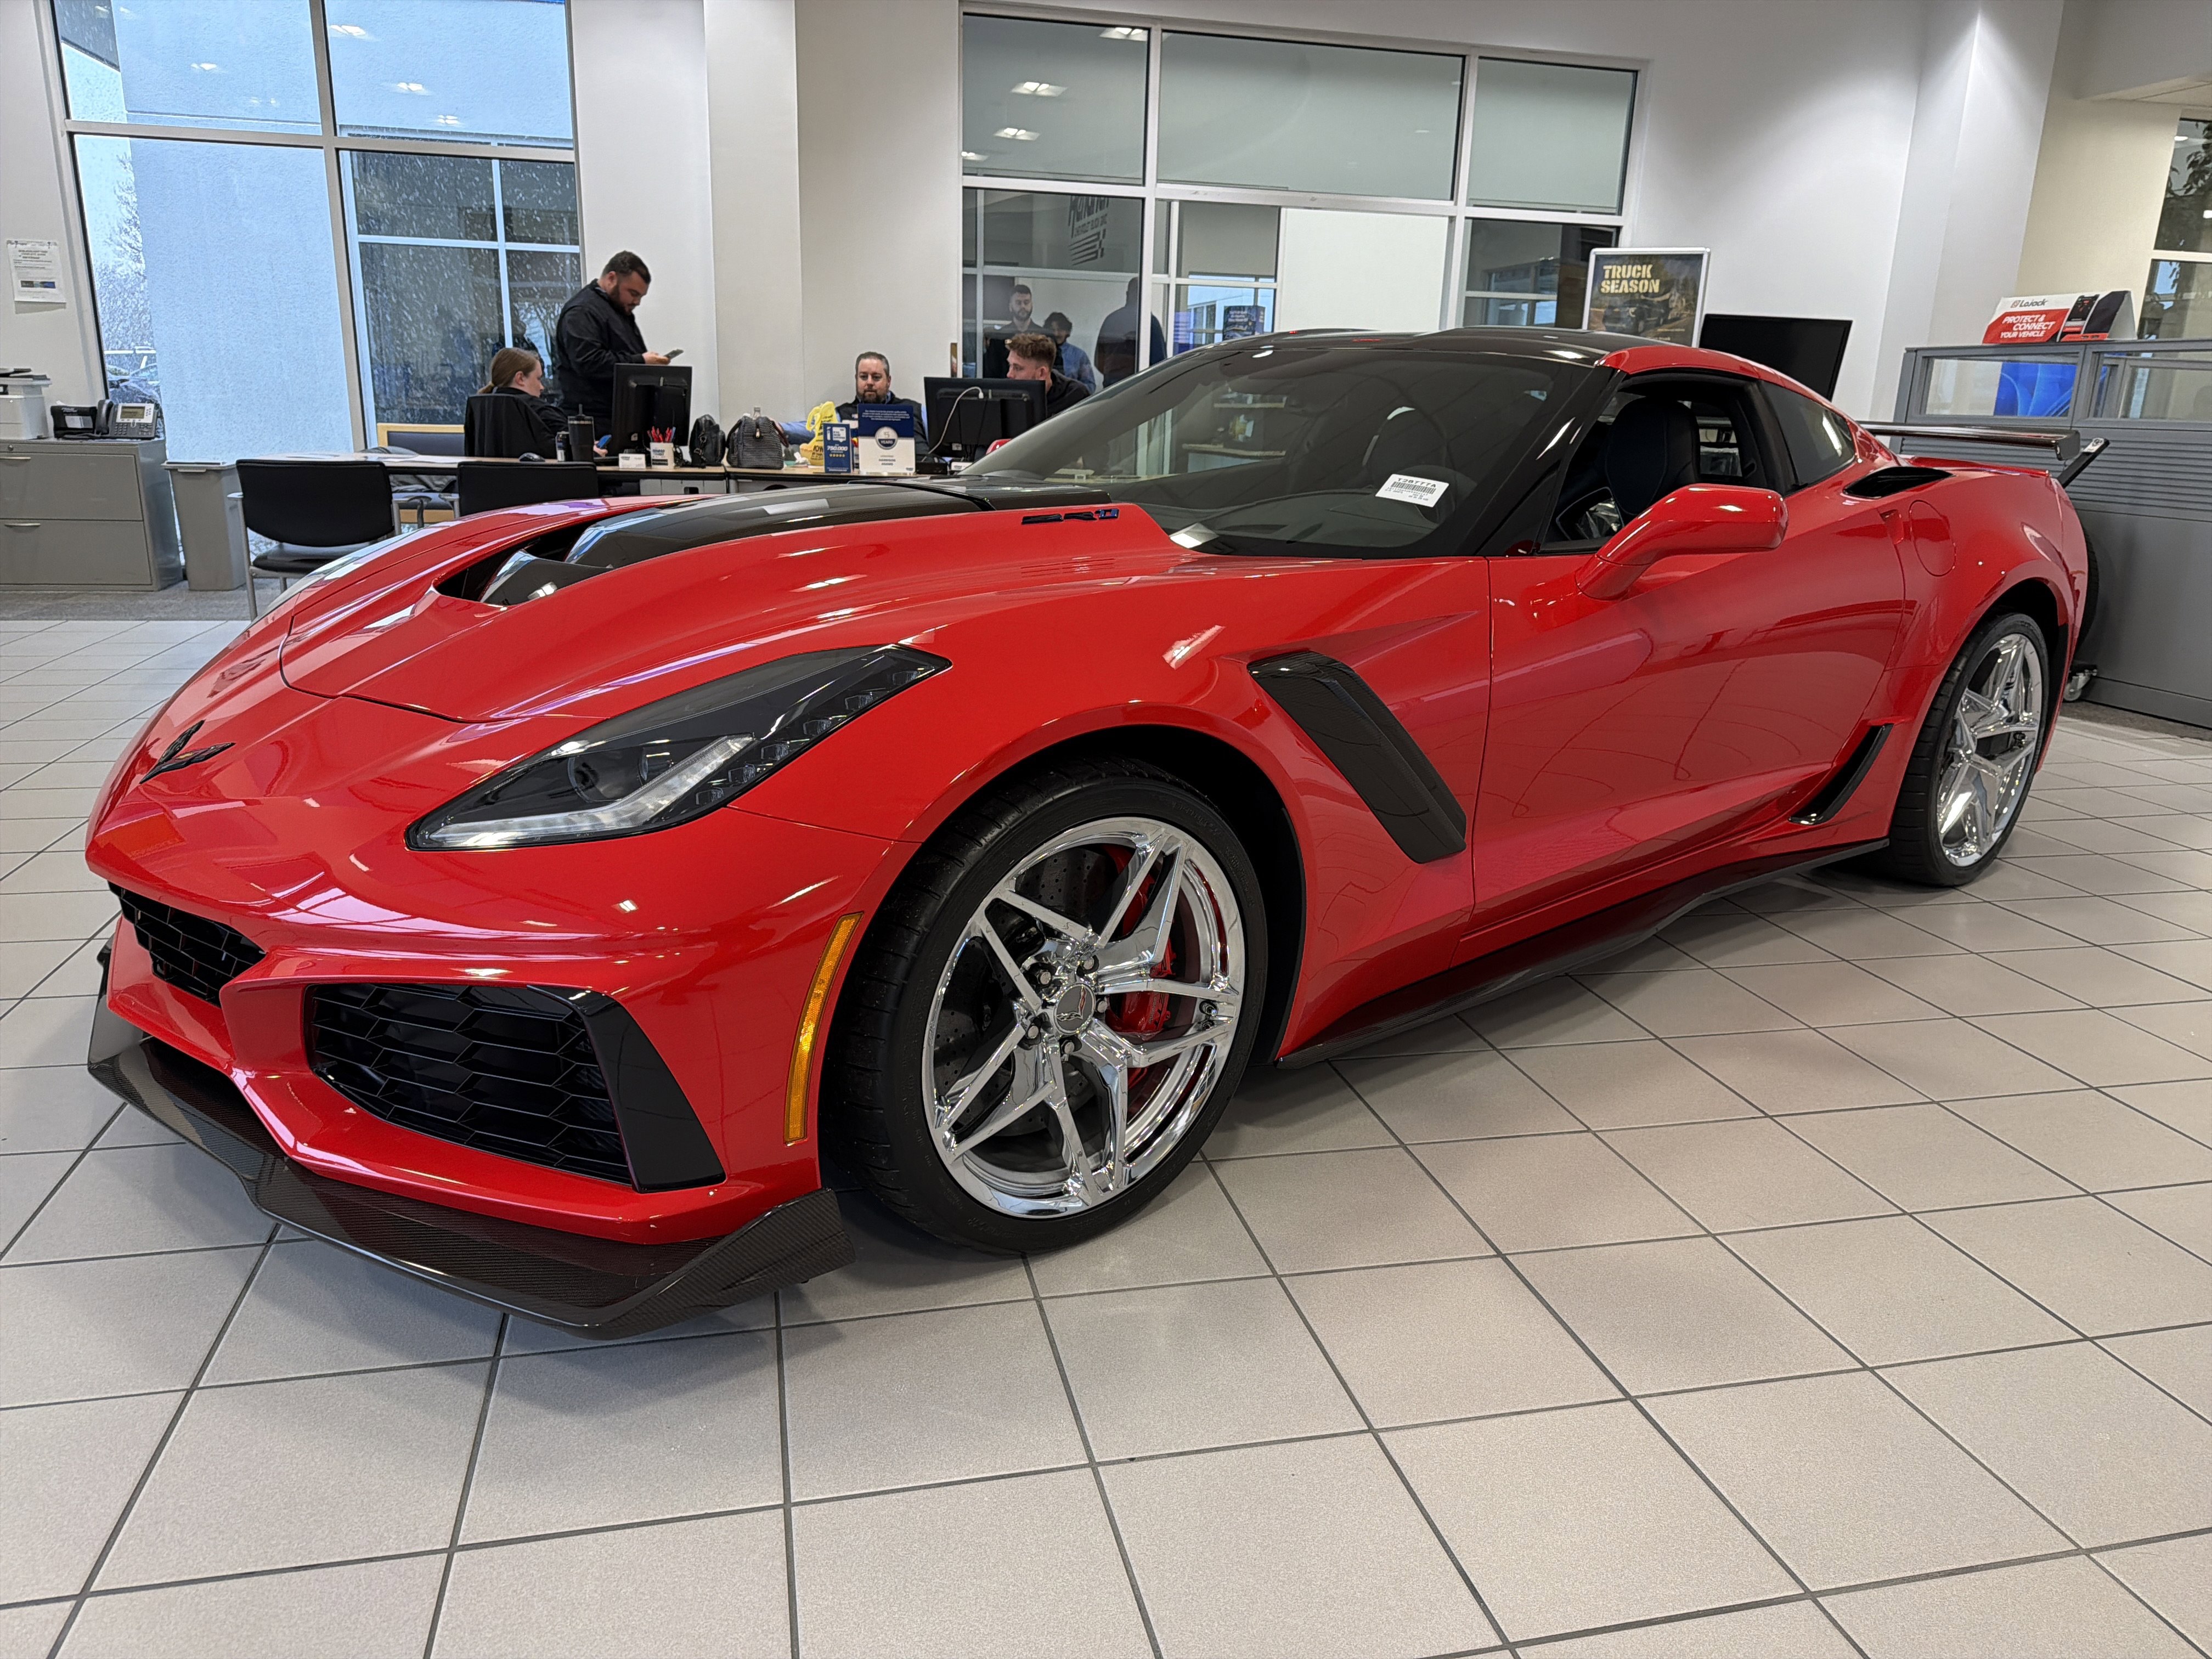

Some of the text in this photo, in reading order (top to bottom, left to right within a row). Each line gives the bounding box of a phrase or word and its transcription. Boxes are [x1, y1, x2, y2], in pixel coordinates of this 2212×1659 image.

[1603, 264, 1652, 279] TRUCK
[1601, 279, 1660, 293] SEASON
[2013, 321, 2056, 330] CONNECT
